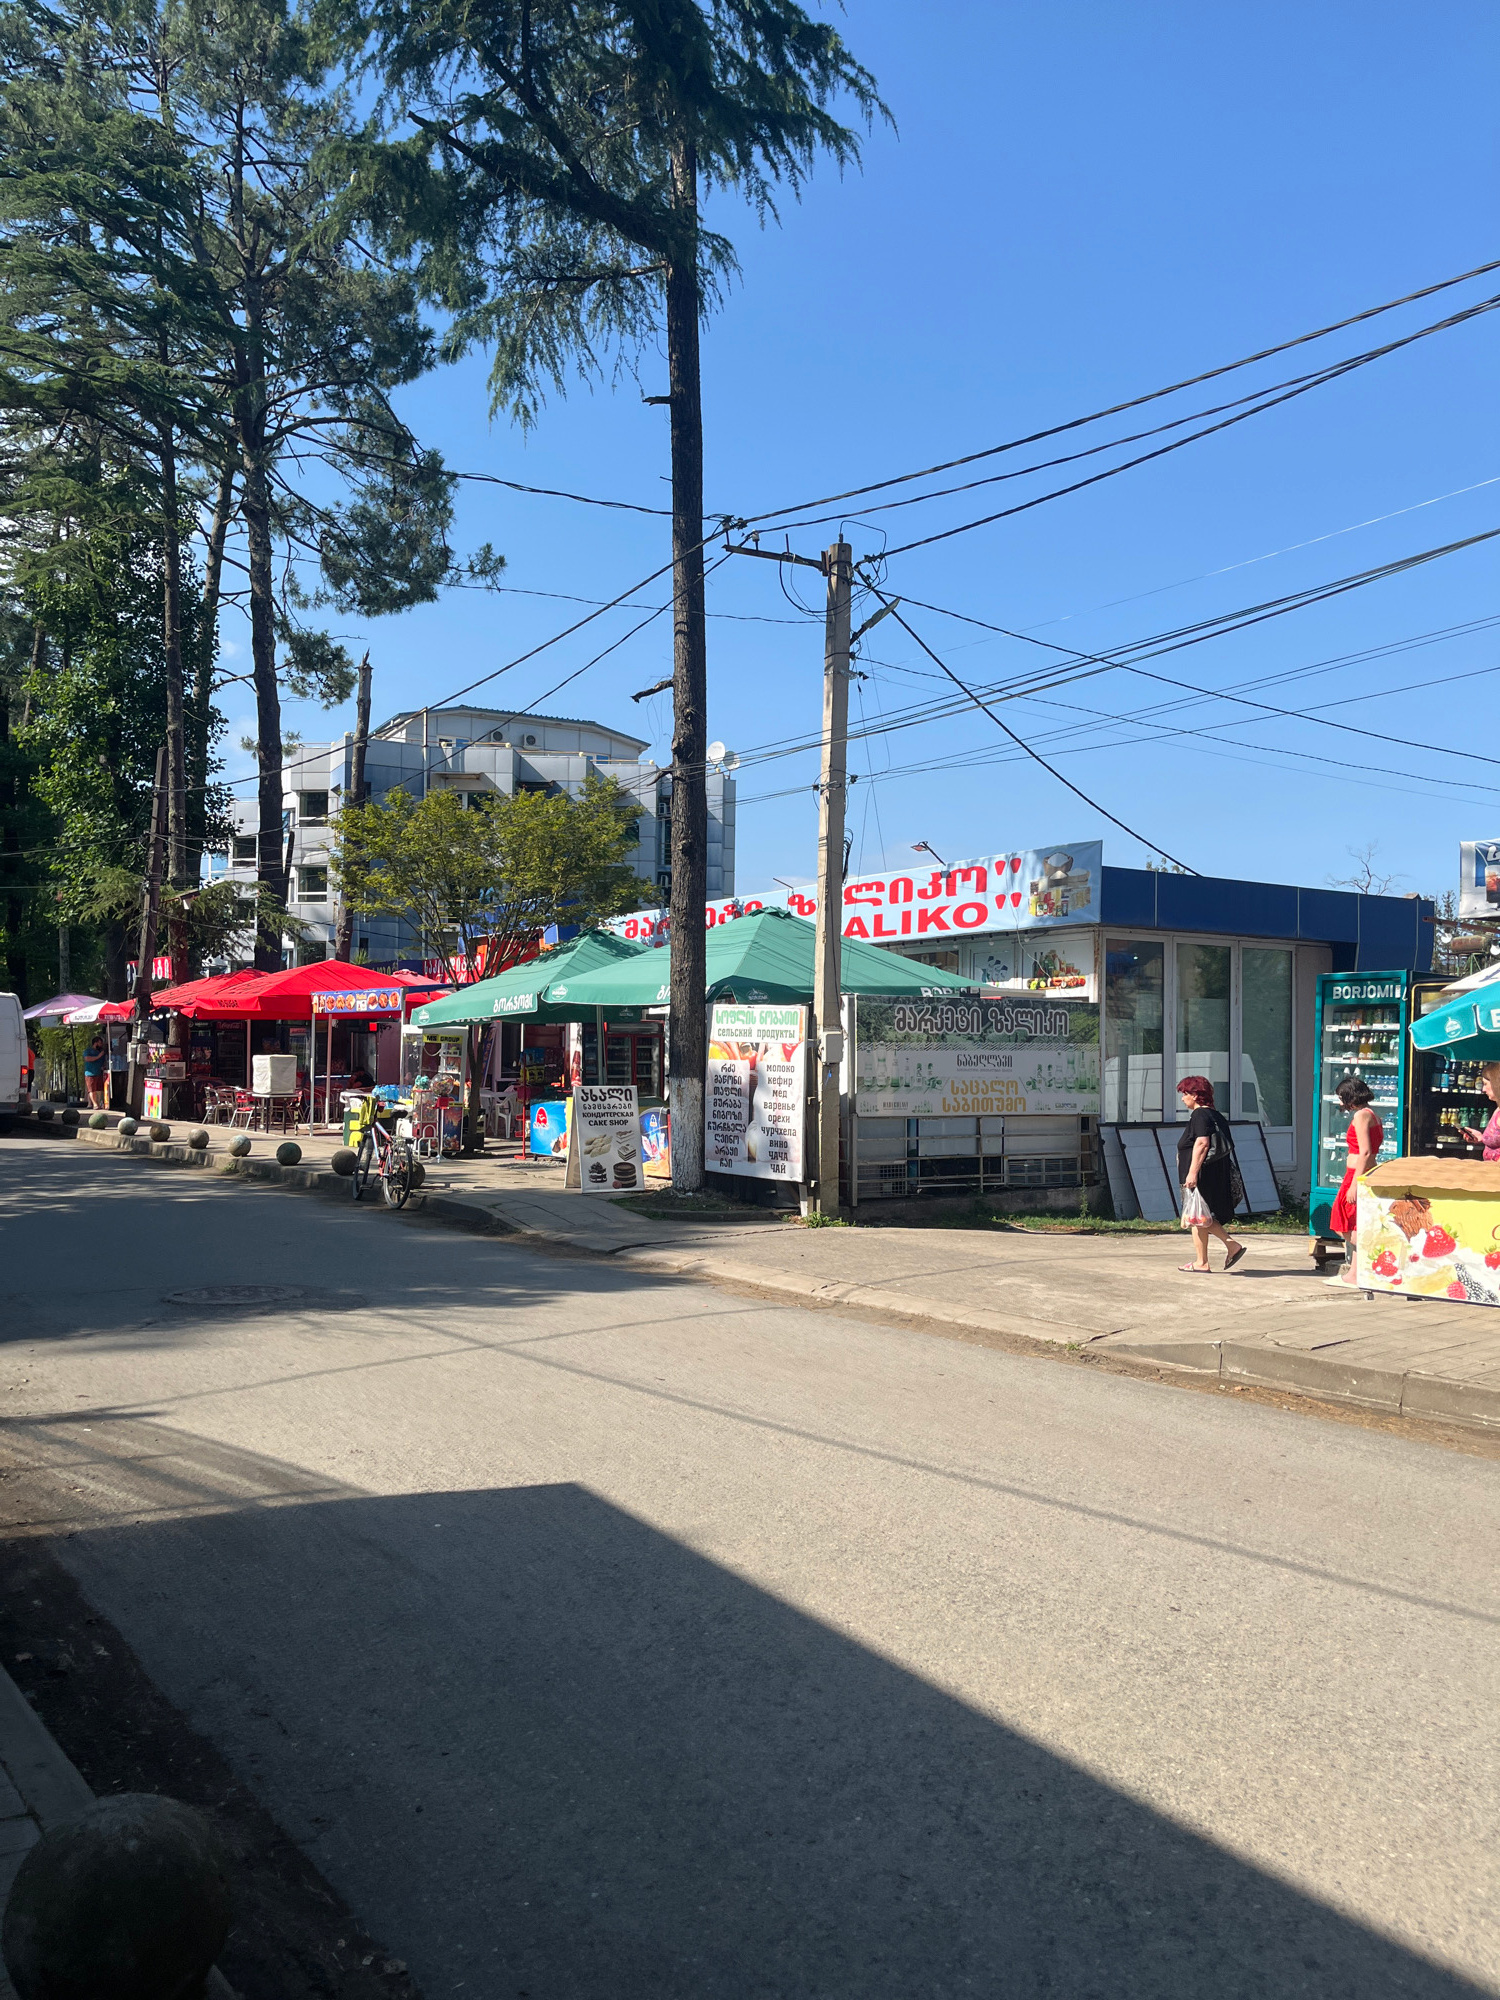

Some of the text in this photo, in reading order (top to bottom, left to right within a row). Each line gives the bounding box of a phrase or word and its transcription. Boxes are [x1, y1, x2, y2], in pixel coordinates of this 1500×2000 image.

[1332, 984, 1393, 999] BORJOMI
[715, 1010, 756, 1025] სოფლის
[895, 1005, 1069, 1036] მარკეტი ზალიკო
[717, 1027, 795, 1041] сельский продукты
[580, 1088, 633, 1102] ახალი
[950, 1079, 1019, 1096] საცალო
[942, 1097, 1027, 1113] საბითუმო
[582, 1111, 634, 1119] КОНДИТЕРСКАЯ
[588, 1119, 629, 1127] CAKE SHOP
